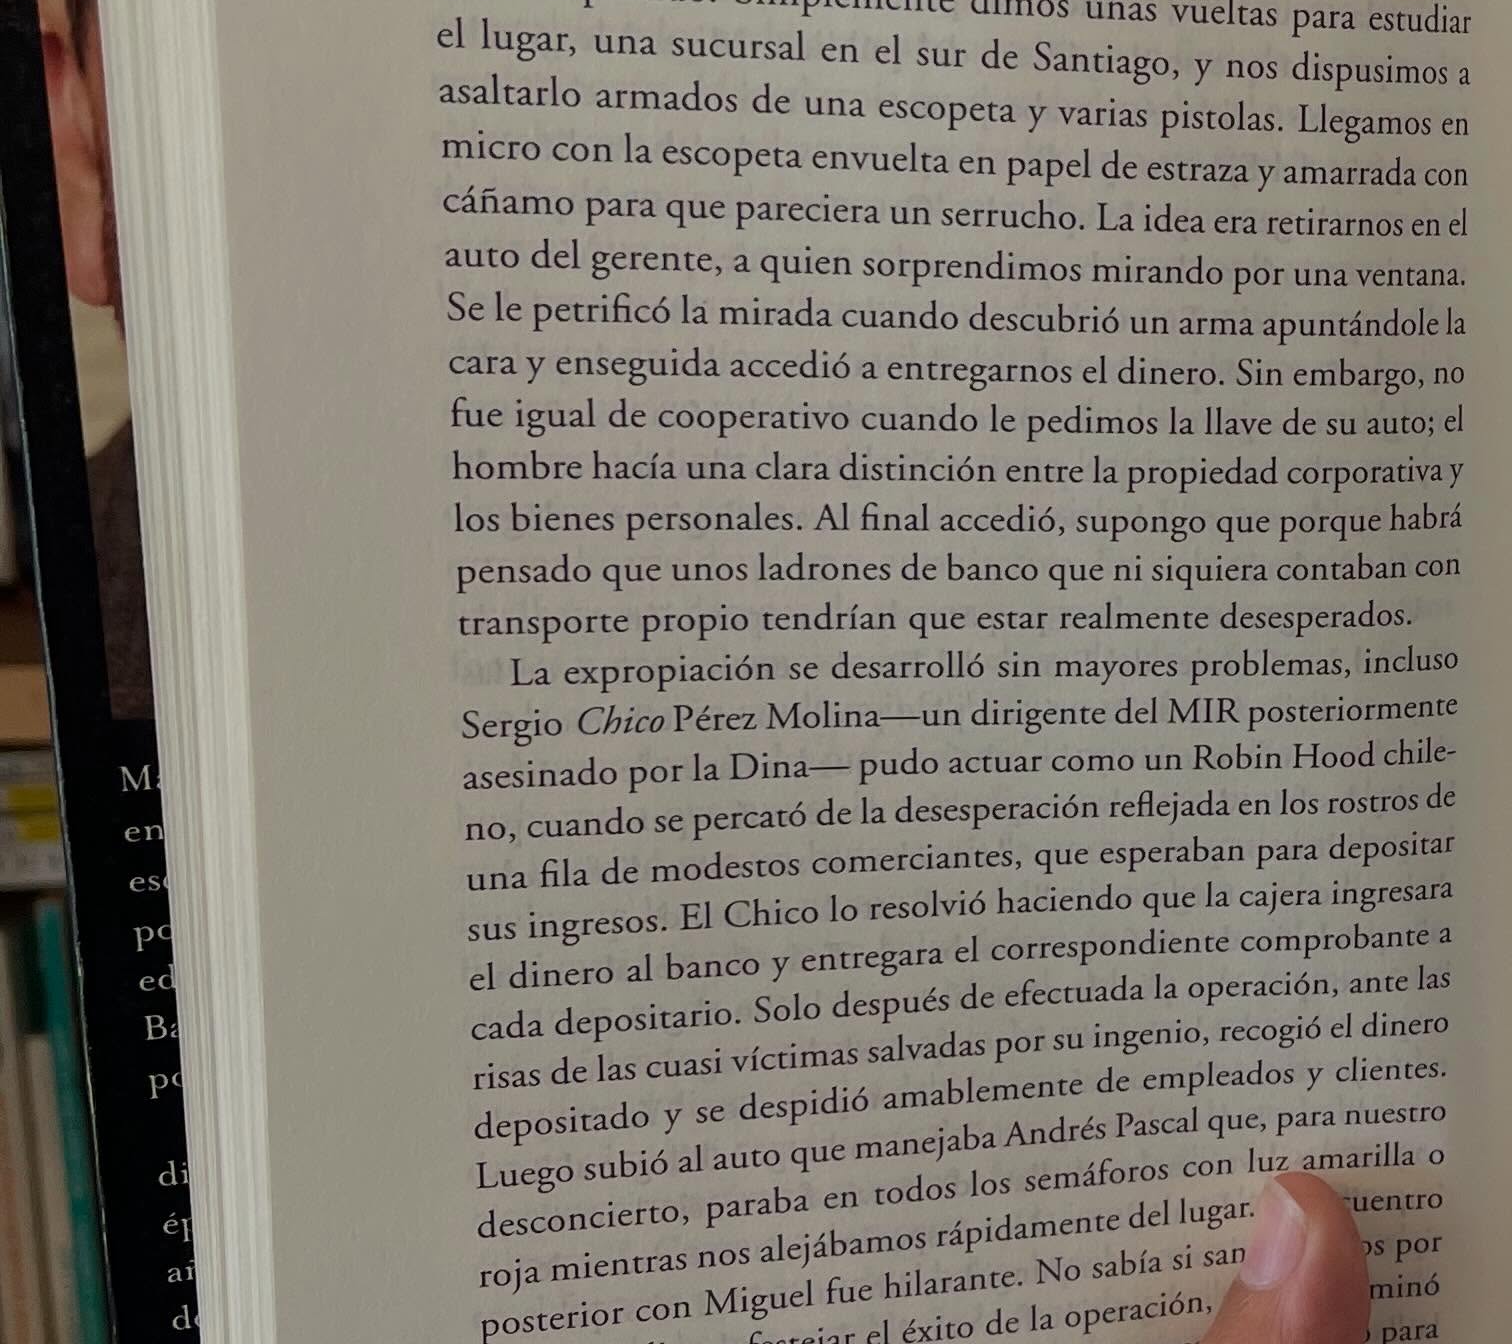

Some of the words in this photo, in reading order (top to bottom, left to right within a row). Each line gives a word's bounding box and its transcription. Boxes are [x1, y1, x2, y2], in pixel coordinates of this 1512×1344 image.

[1084, 0, 1158, 23] unas
[1290, 7, 1358, 40] para
[1367, 1, 1473, 36] estudiar
[438, 71, 583, 109] asaltarlo
[594, 78, 739, 114] armados
[750, 81, 792, 116] de
[803, 95, 867, 119] una
[877, 98, 1018, 132] escopeta
[1026, 104, 1049, 135] y
[1056, 96, 1149, 129] varias
[1159, 98, 1285, 140] pistolas.
[1296, 102, 1433, 146] Llegamos
[1440, 116, 1470, 137] en
[453, 500, 501, 534] los
[509, 500, 616, 533] bienes
[625, 500, 804, 542] personales.
[812, 500, 851, 532] Al
[859, 500, 931, 533] final
[938, 502, 1066, 538] accedió,
[1074, 514, 1208, 544] supongo
[1215, 514, 1272, 544] que
[1277, 513, 1383, 544] porque
[1388, 500, 1464, 533] habrá
[509, 656, 553, 688] La
[563, 652, 777, 695] expropiación
[787, 661, 820, 682] se
[830, 648, 986, 681] desarrolló
[996, 650, 1042, 679] sin
[1053, 658, 1179, 687] mayores
[1189, 647, 1352, 687] problemas,
[1362, 643, 1460, 676] incluso
[473, 1099, 651, 1148] depositado
[662, 1107, 684, 1137] y
[694, 1104, 727, 1125] se
[737, 1084, 870, 1128] despidió
[882, 1075, 1085, 1111] amablemente
[1095, 1064, 1131, 1095] de
[1141, 1058, 1296, 1098] empleados
[1305, 1066, 1326, 1093] y
[1334, 1054, 1448, 1084] clientes.
